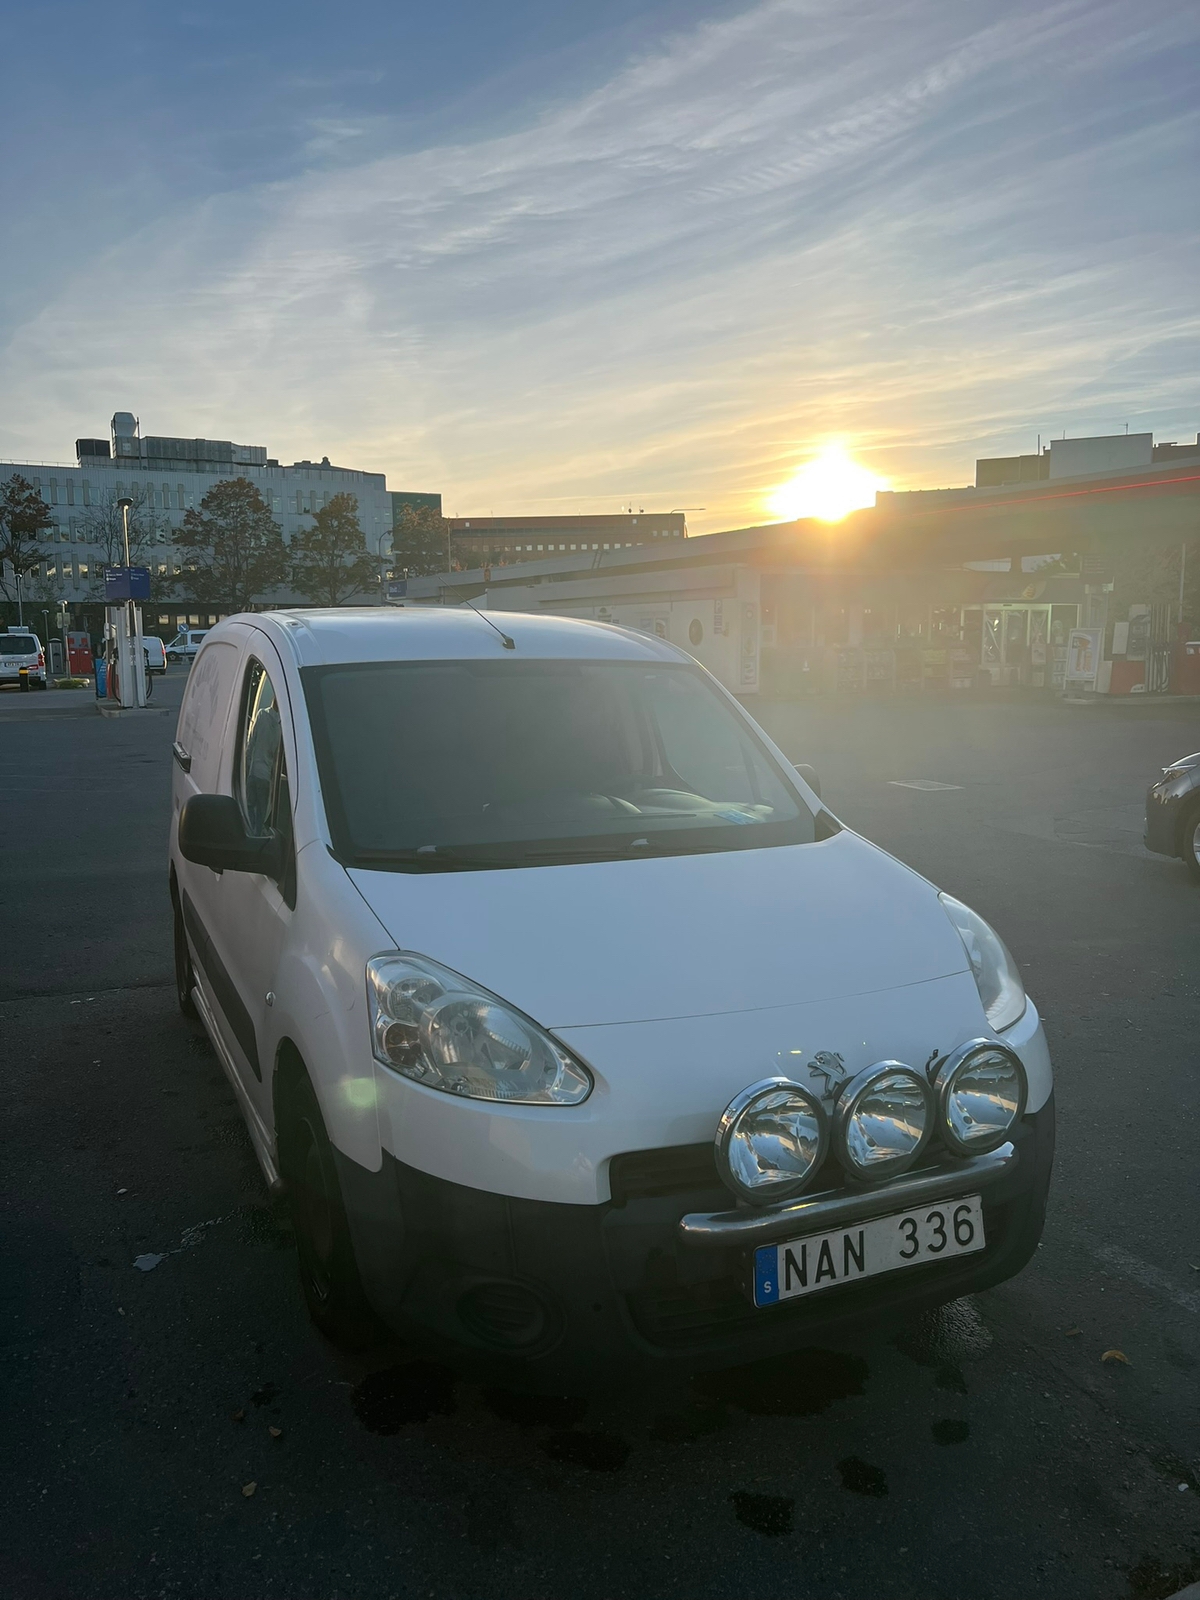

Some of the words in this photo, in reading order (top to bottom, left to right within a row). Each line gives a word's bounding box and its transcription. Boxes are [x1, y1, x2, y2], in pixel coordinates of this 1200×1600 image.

[785, 1230, 865, 1291] NAN
[898, 1204, 975, 1259] 336
[763, 1281, 772, 1293] S
